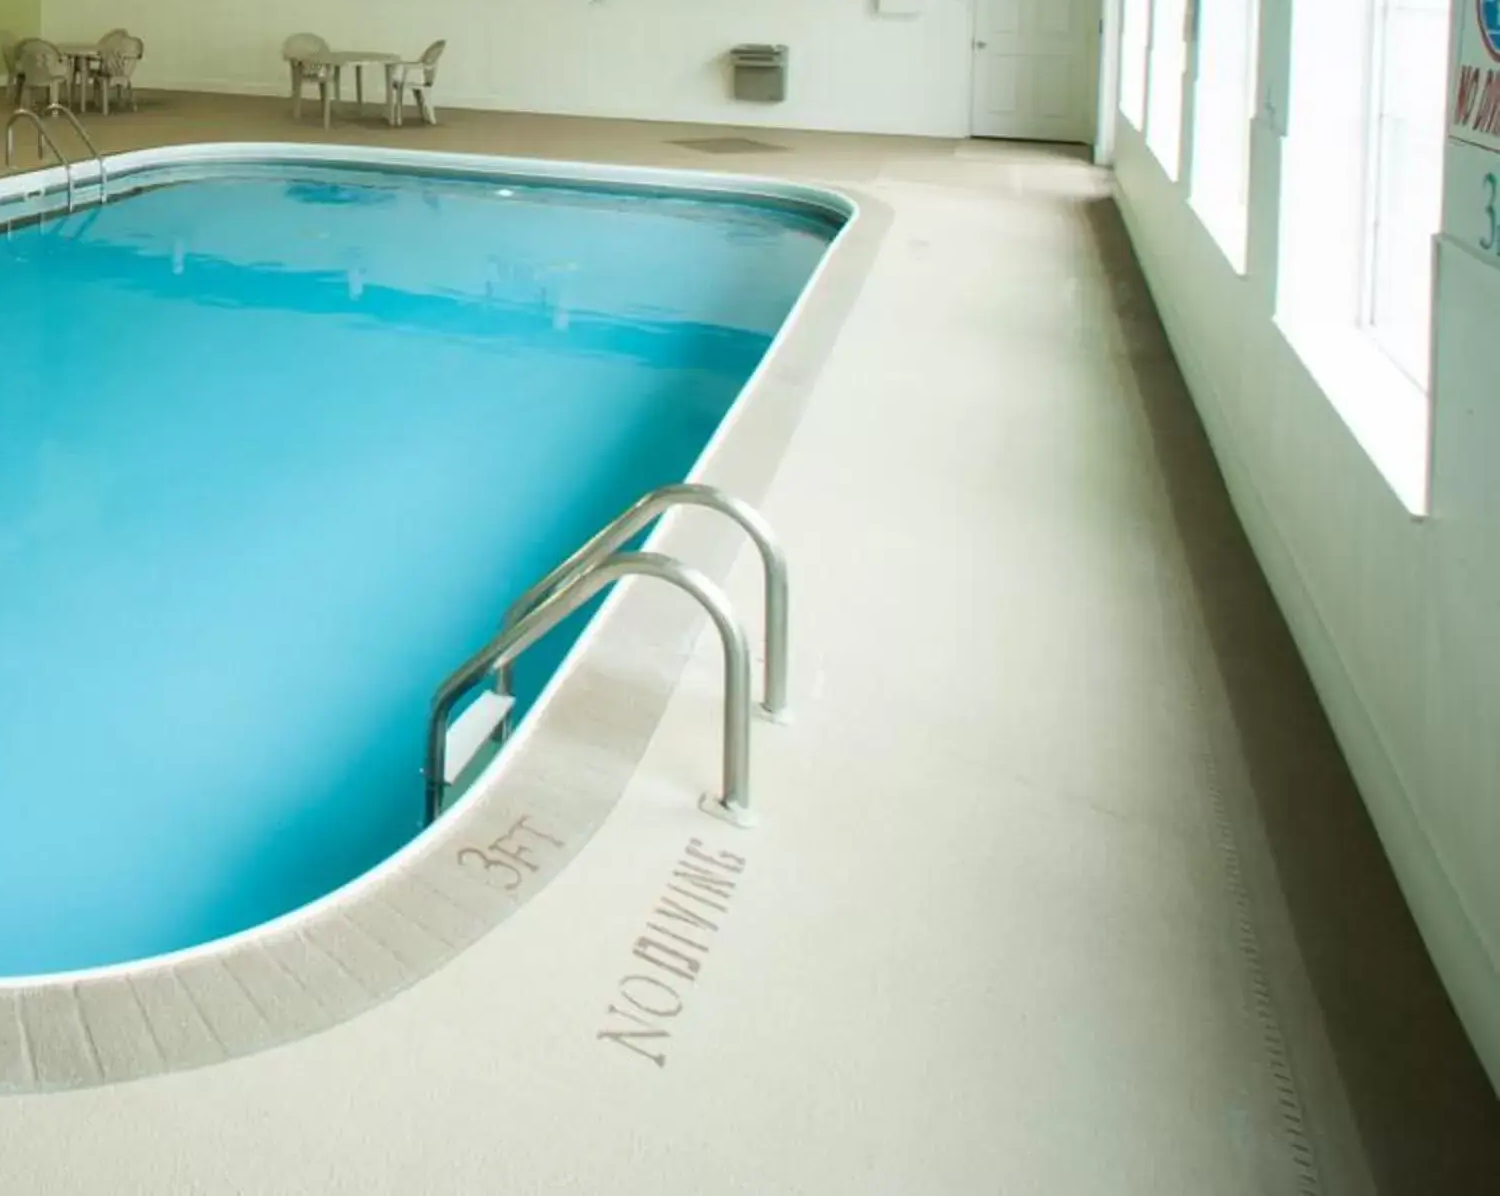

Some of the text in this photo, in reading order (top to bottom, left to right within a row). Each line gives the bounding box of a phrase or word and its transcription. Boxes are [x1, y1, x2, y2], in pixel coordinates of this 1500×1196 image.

[457, 814, 565, 892] 3FT
[596, 837, 746, 1068] NO DIVING
